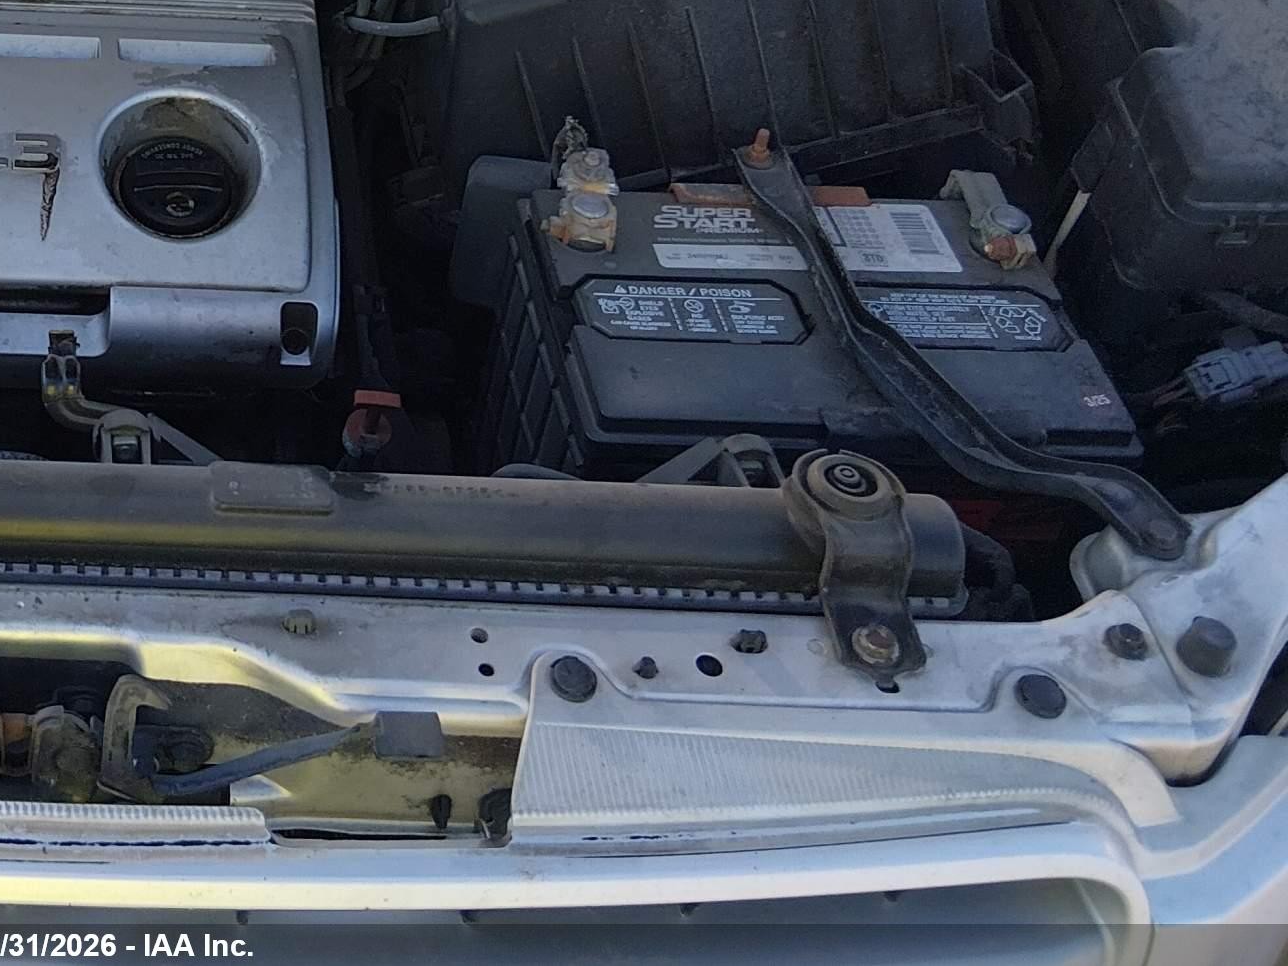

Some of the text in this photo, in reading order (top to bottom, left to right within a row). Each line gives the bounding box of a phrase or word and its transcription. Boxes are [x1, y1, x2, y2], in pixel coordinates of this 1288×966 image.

[661, 205, 752, 219] SUPER
[653, 214, 756, 229] START
[627, 286, 752, 298] DANGER / POISON
